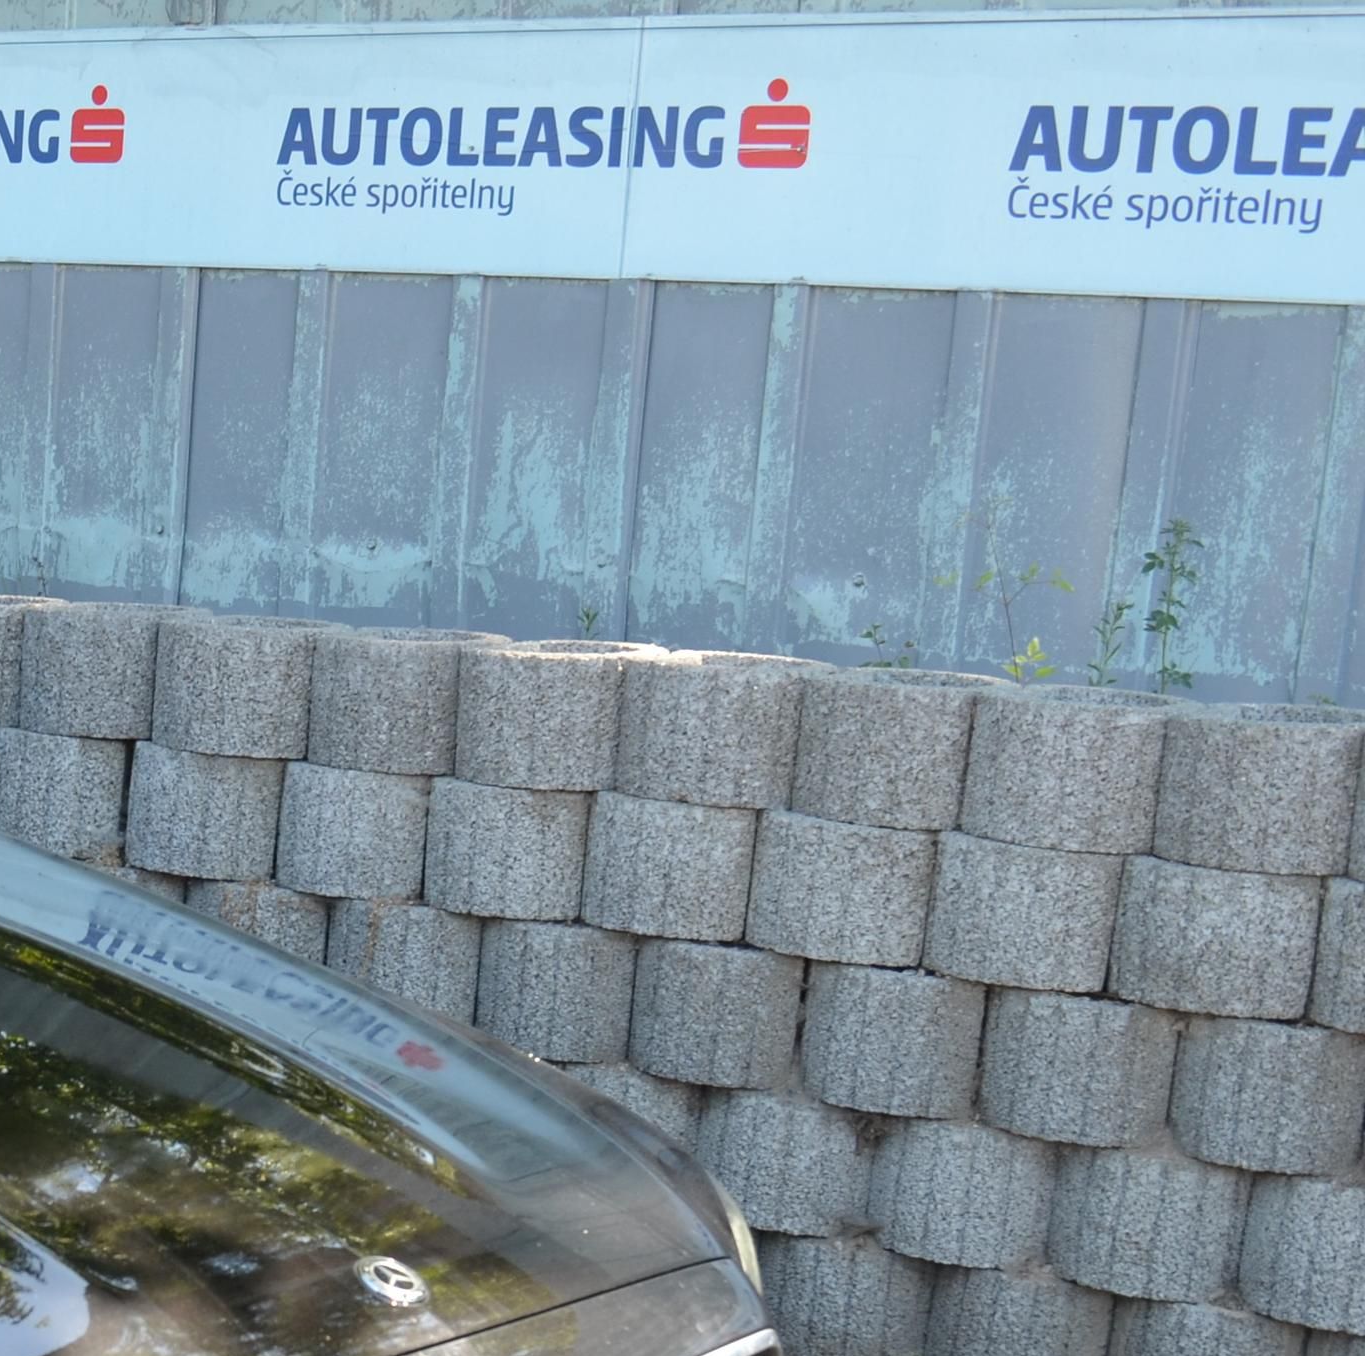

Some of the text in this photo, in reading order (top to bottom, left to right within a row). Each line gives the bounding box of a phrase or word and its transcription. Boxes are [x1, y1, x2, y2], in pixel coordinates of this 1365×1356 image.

[276, 105, 726, 168] AUTOLEASING
[276, 169, 515, 217] České spořitelny
[1008, 176, 1323, 234] České spořitelny
